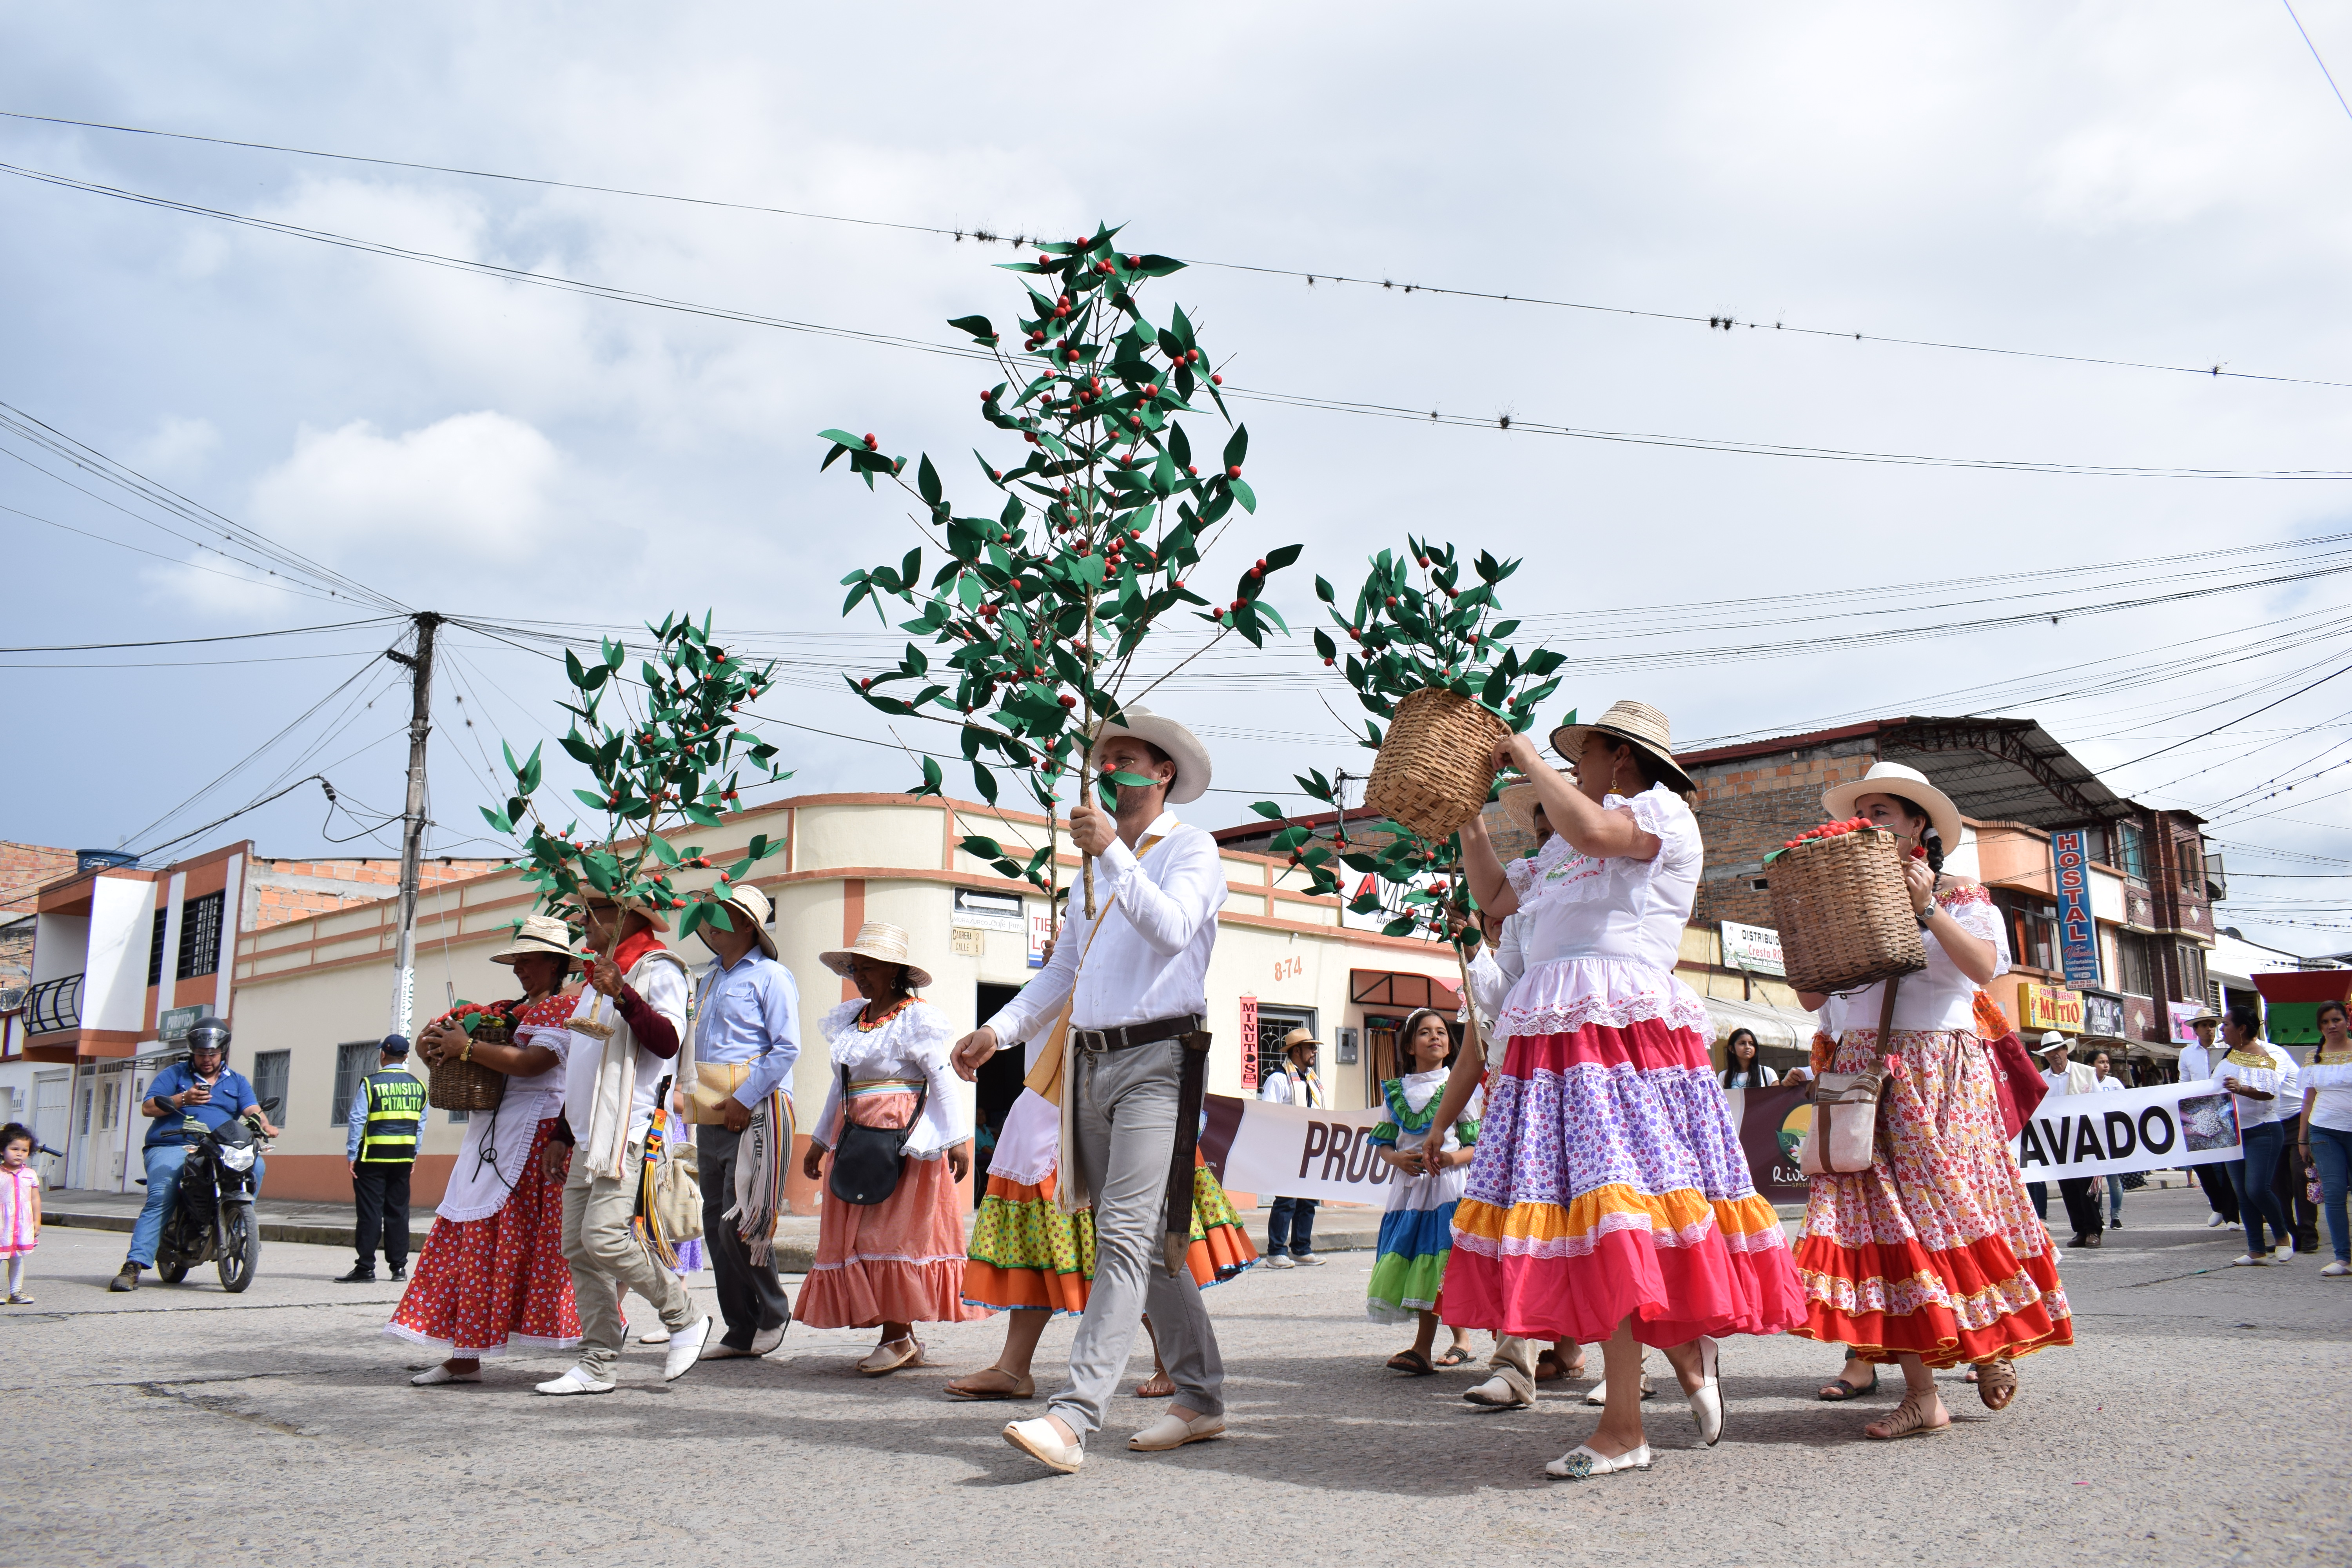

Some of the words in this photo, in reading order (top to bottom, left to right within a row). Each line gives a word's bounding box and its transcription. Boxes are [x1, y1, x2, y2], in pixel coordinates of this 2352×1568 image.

[2056, 833, 2089, 942] HOSTAL
[1033, 916, 1065, 932] TIEN
[953, 929, 972, 940] CARRERA
[955, 942, 969, 951] CALLE
[975, 944, 978, 953] 9
[1748, 944, 1770, 958] Cresta
[1275, 956, 1302, 982] 8-74
[2040, 988, 2076, 1000] COMPRAVENTA
[2040, 997, 2056, 1020] MI
[2058, 1002, 2080, 1023] TIO
[374, 1082, 422, 1097] TRANSITO
[381, 1096, 421, 1111] PITALITO
[2017, 1105, 2175, 1169] AVADO
